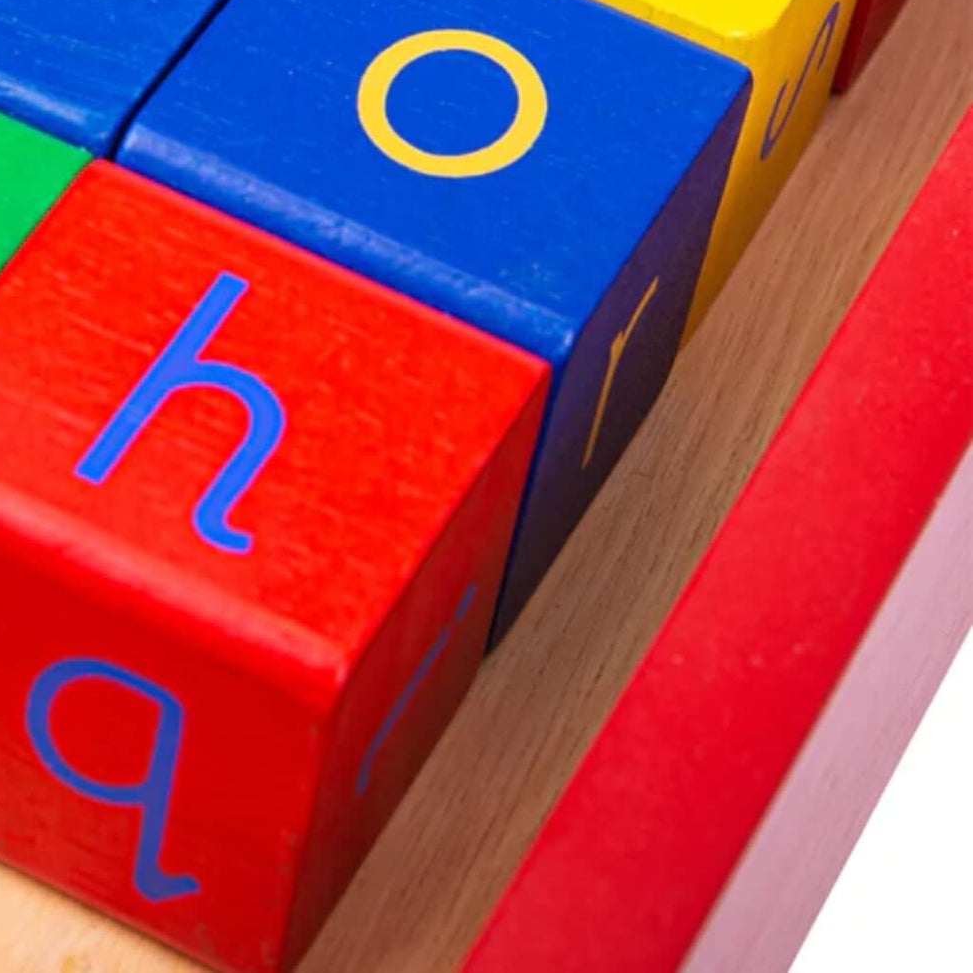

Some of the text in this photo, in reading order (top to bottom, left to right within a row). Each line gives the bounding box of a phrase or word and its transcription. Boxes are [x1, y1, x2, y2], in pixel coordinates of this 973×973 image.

[358, 30, 547, 177] o
[76, 273, 285, 553] h
[27, 657, 200, 902] q
